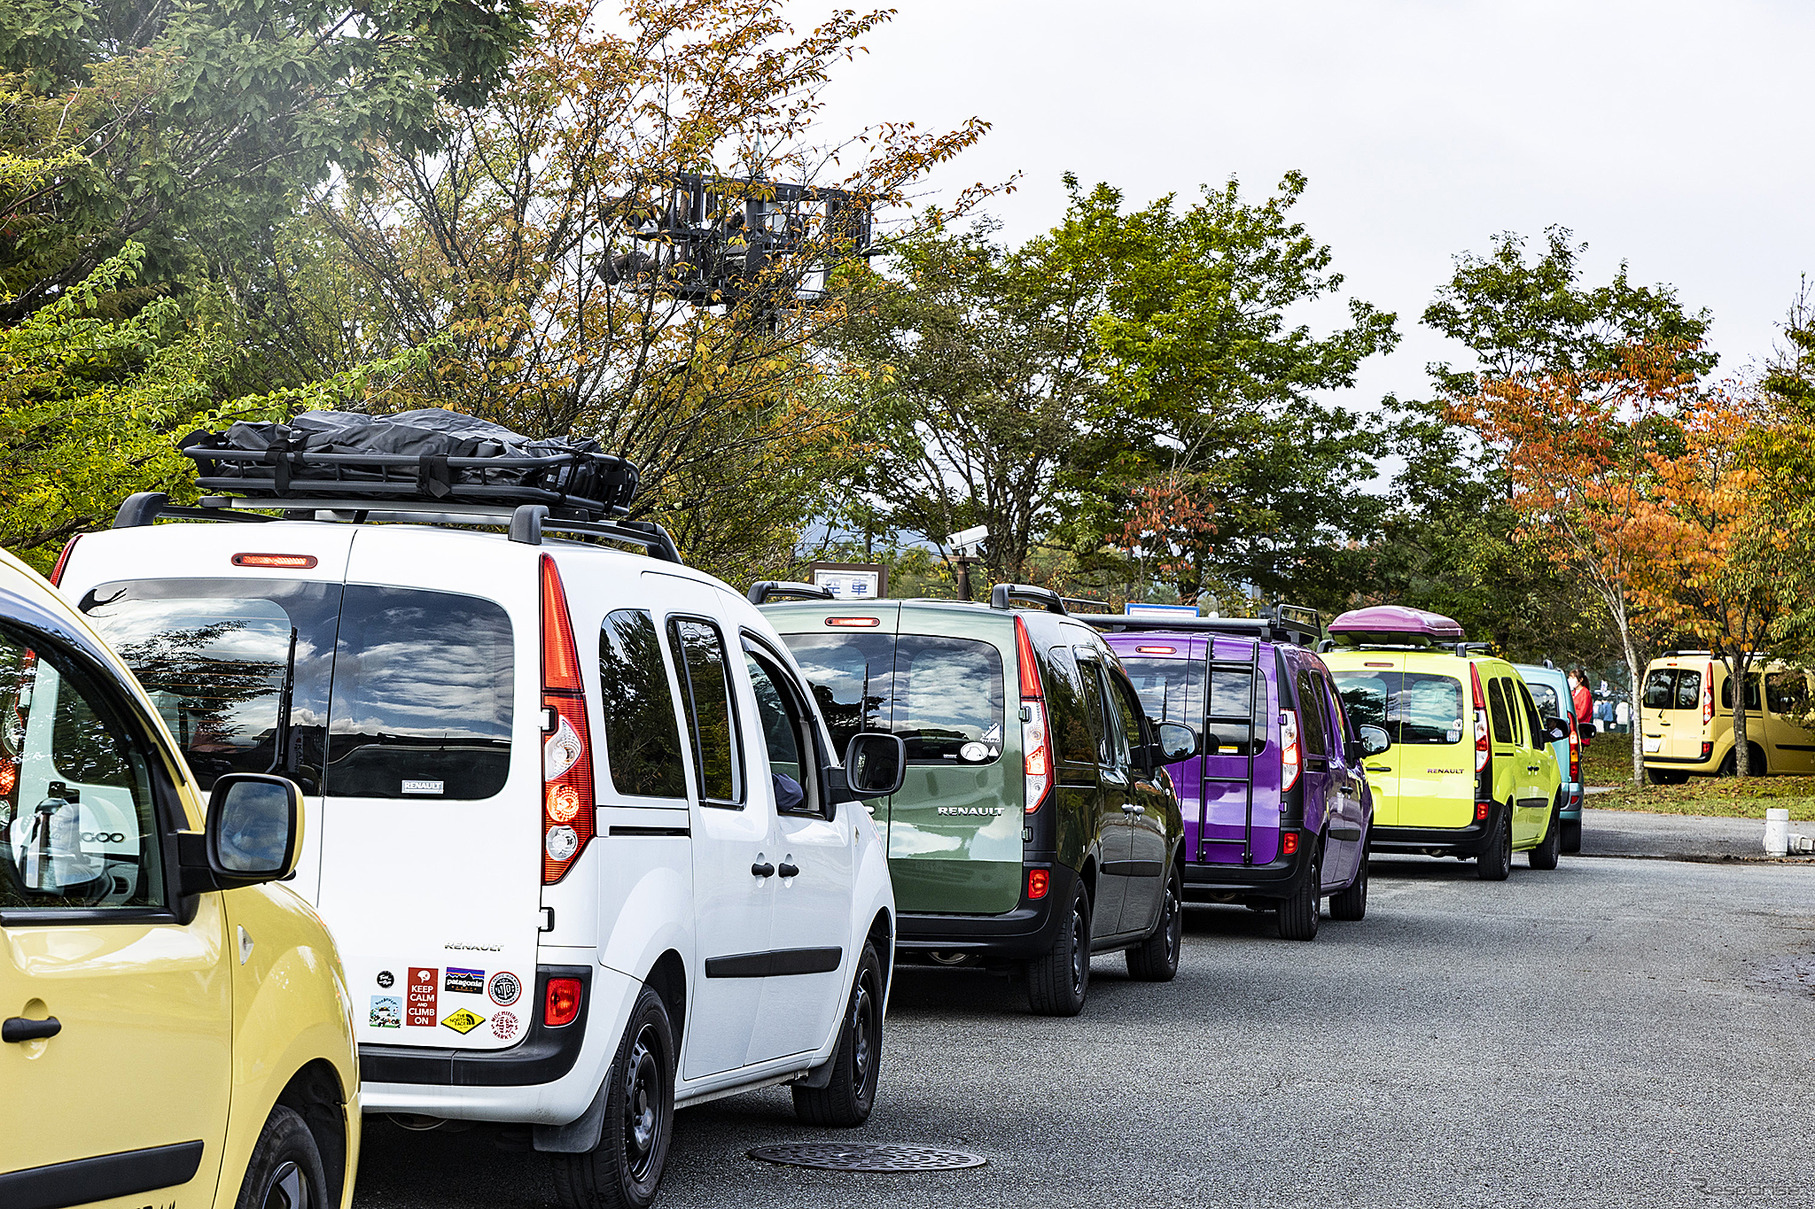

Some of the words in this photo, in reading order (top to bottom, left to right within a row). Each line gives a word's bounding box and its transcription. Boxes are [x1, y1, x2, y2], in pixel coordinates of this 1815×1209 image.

[404, 781, 442, 790] RENAULT
[937, 806, 1005, 817] RENAULT
[445, 942, 504, 951] RENAULT
[446, 979, 483, 987] patagonia
[411, 985, 434, 993] KEEP
[409, 993, 435, 1002] CALM
[408, 1007, 435, 1016] CLIMB
[414, 1017, 429, 1025] ON
[493, 1030, 516, 1039] MARKET
